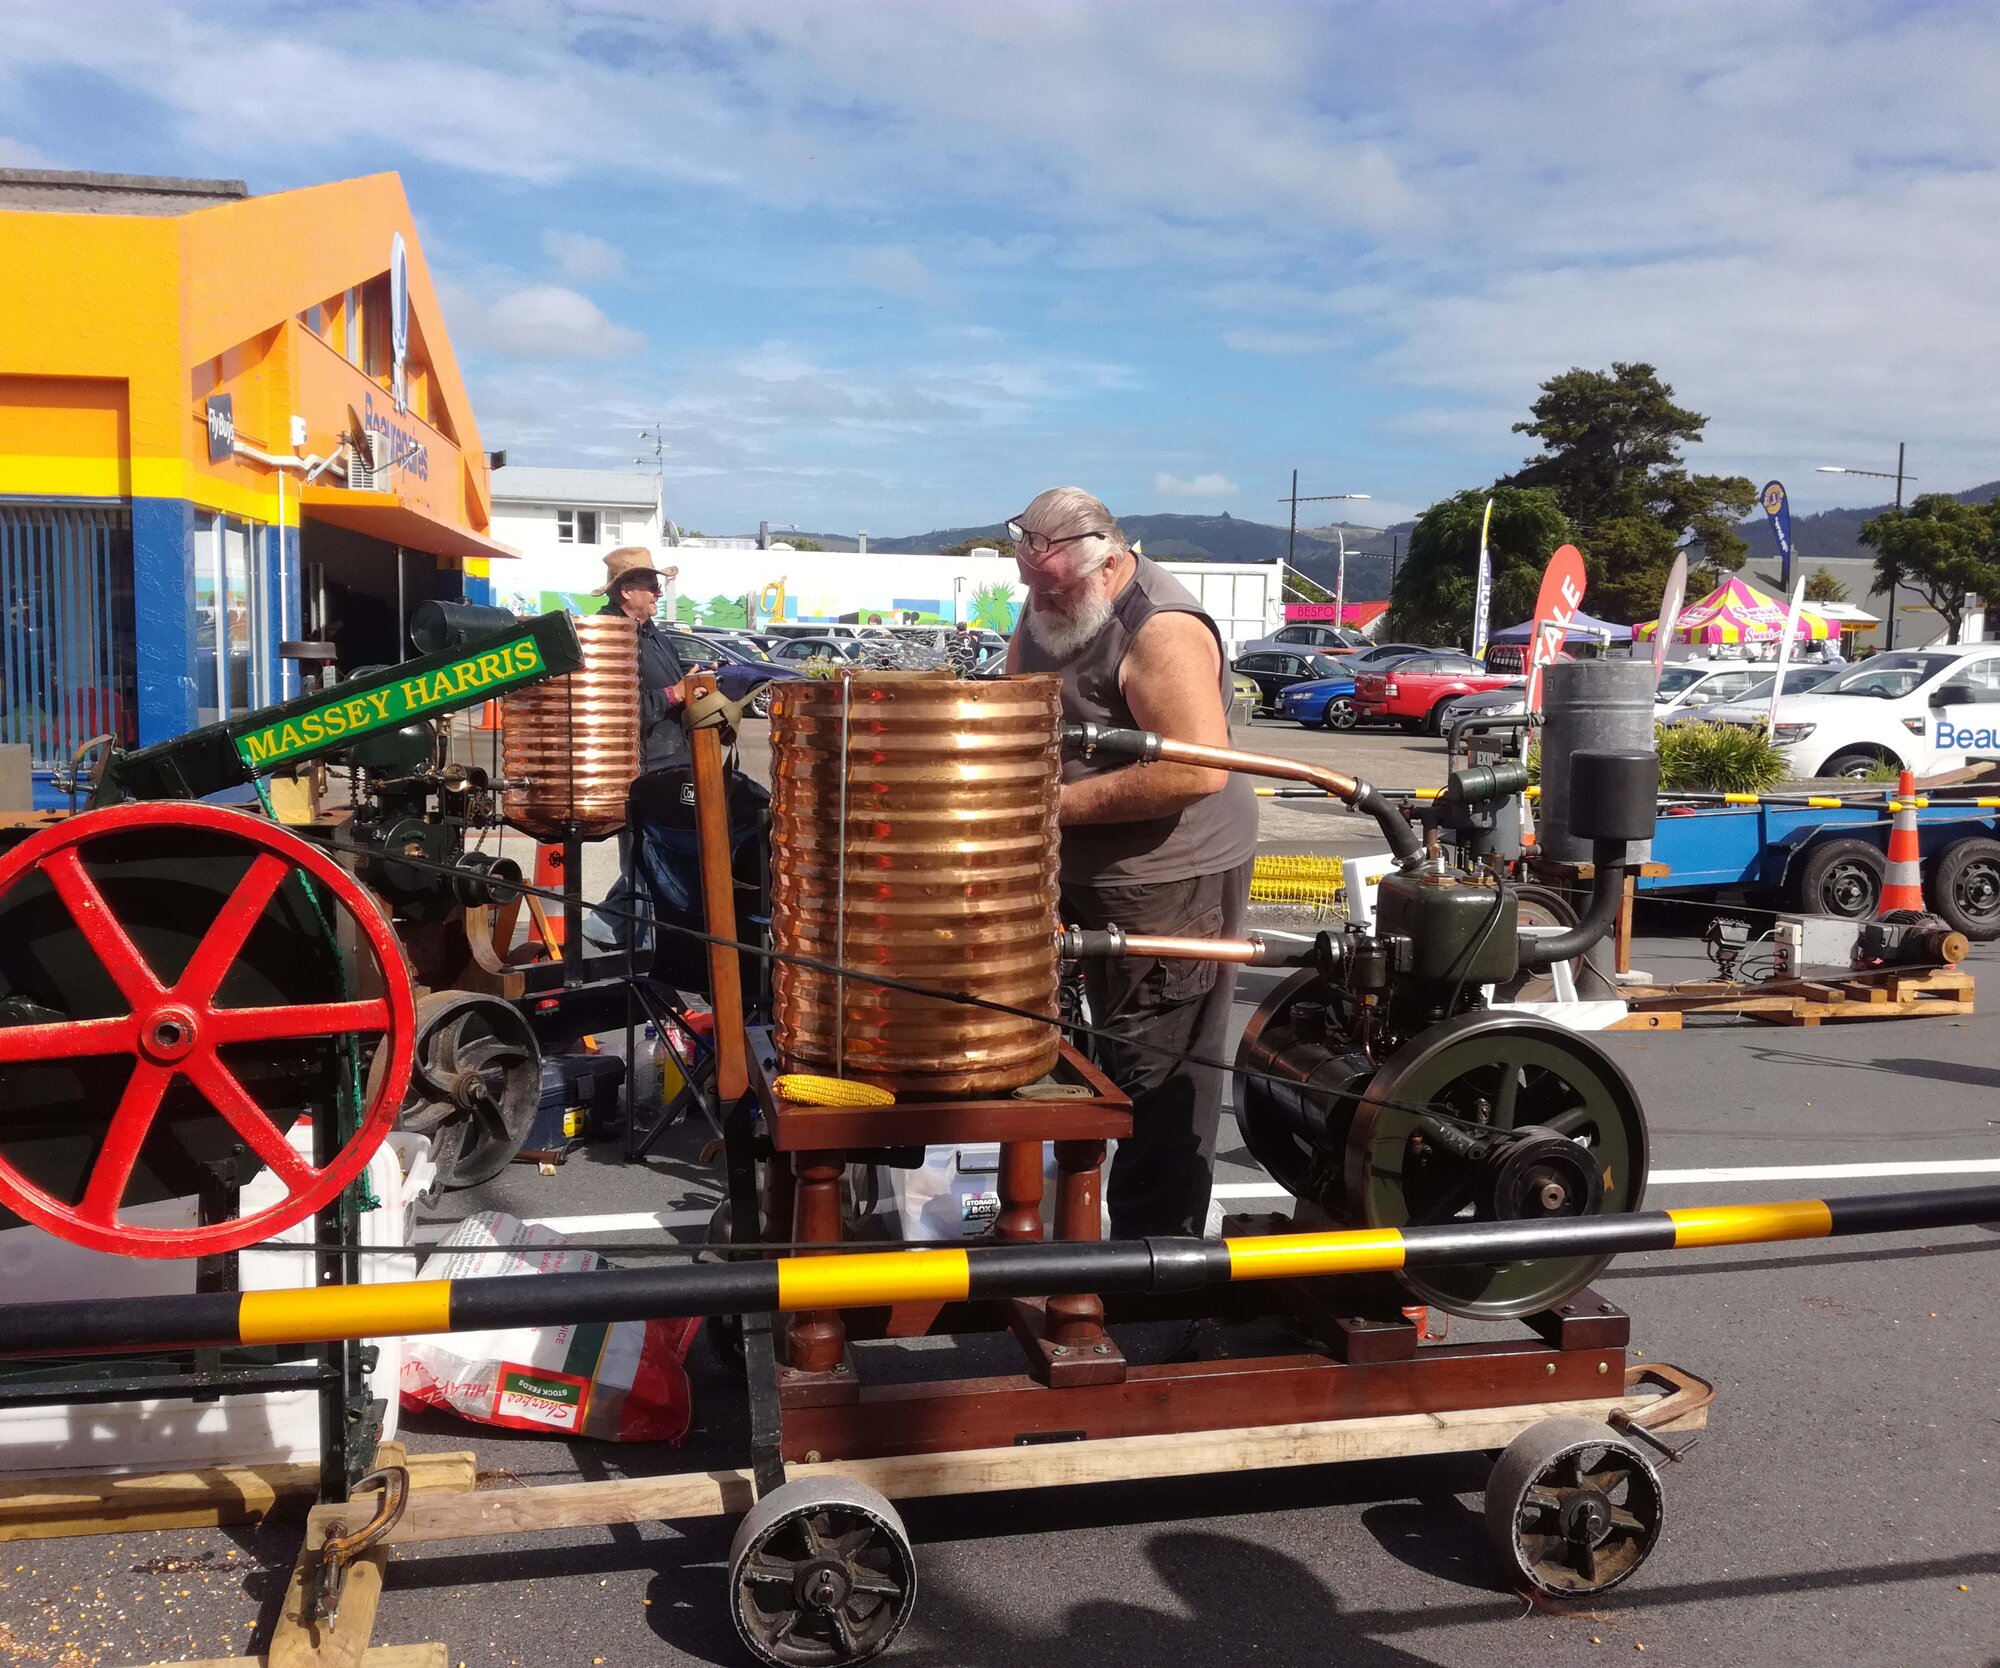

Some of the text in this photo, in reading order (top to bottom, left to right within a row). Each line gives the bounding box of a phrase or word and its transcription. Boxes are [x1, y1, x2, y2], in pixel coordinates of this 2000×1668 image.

[1297, 605, 1348, 618] BESPOE
[1534, 574, 1581, 670] SALE
[245, 641, 538, 762] MASSEY HARRIS
[518, 1379, 568, 1397] STOCK FEEDS
[507, 1393, 573, 1419] Sharpes
